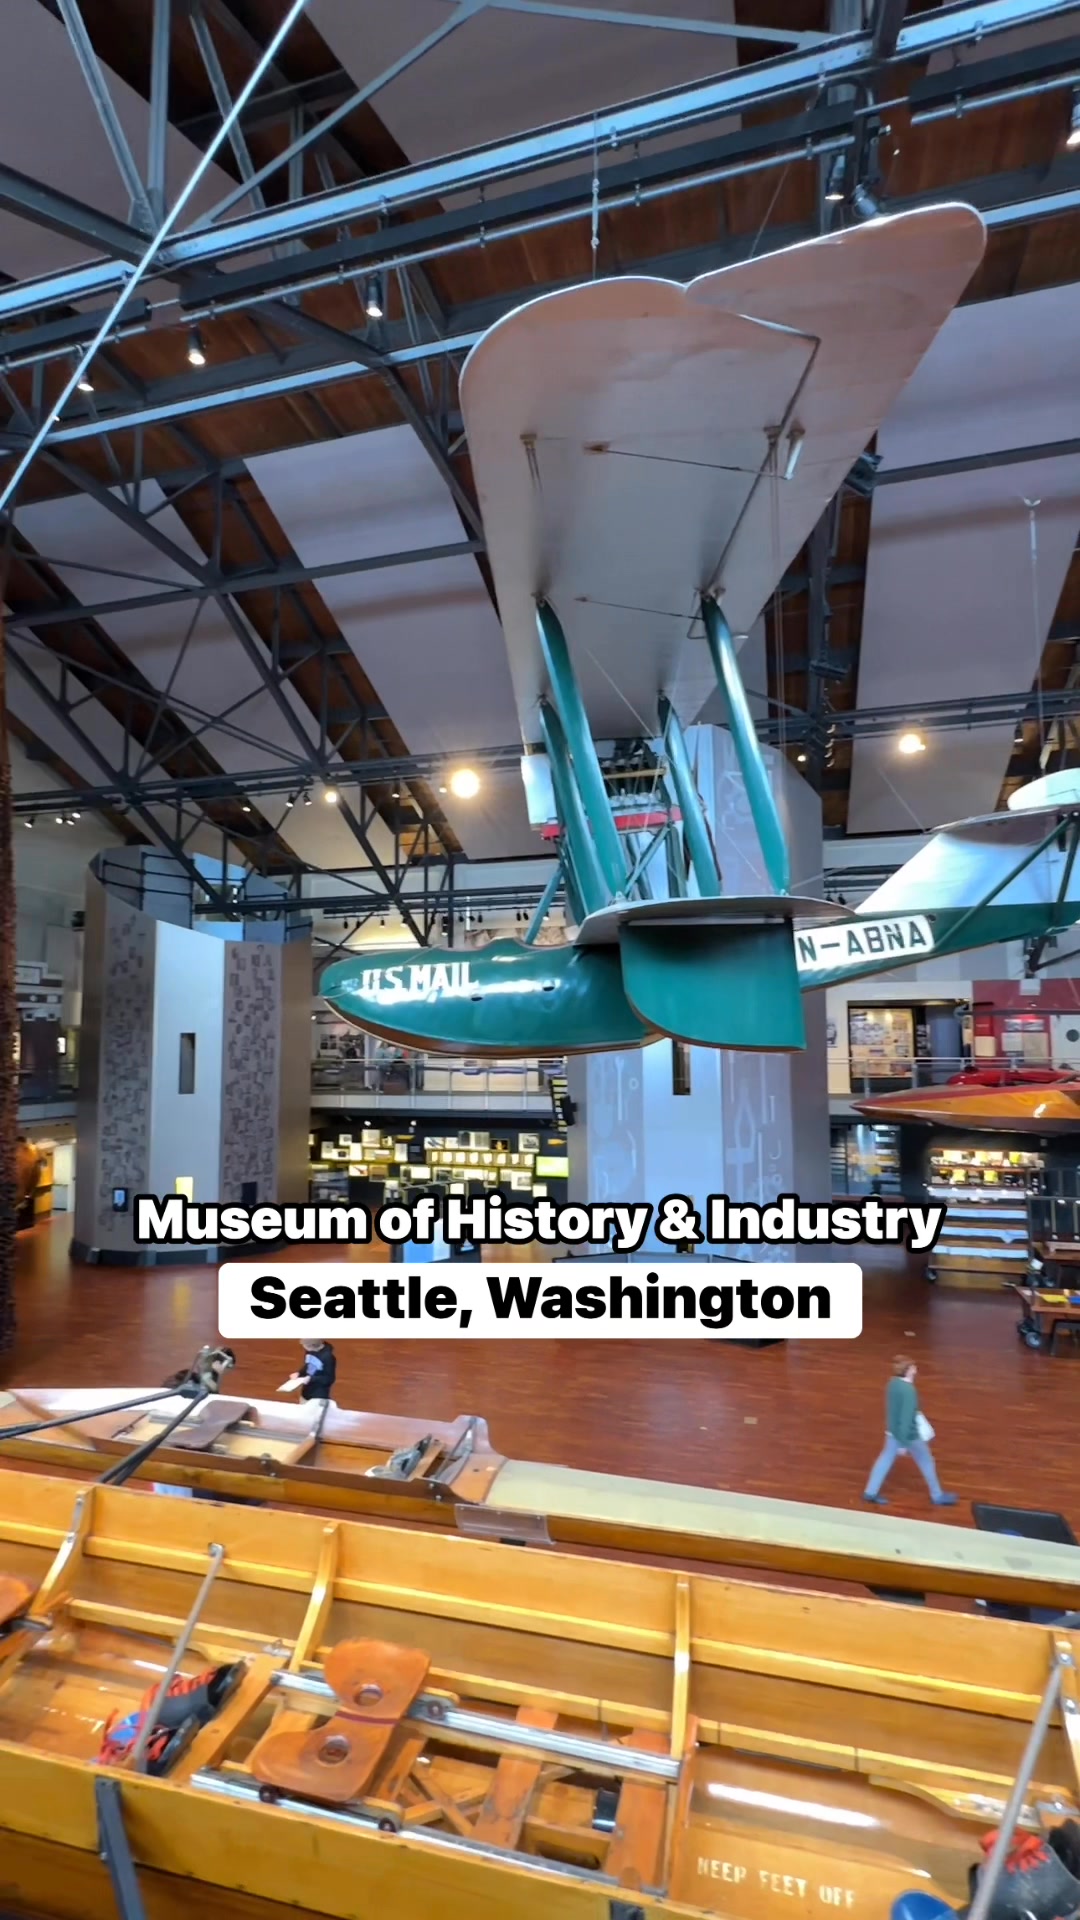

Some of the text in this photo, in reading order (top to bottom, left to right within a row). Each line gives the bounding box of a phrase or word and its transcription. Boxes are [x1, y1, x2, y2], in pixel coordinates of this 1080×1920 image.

[798, 921, 927, 963] N-ABNA
[407, 962, 480, 993] MAIL
[759, 1869, 807, 1898] FEET
